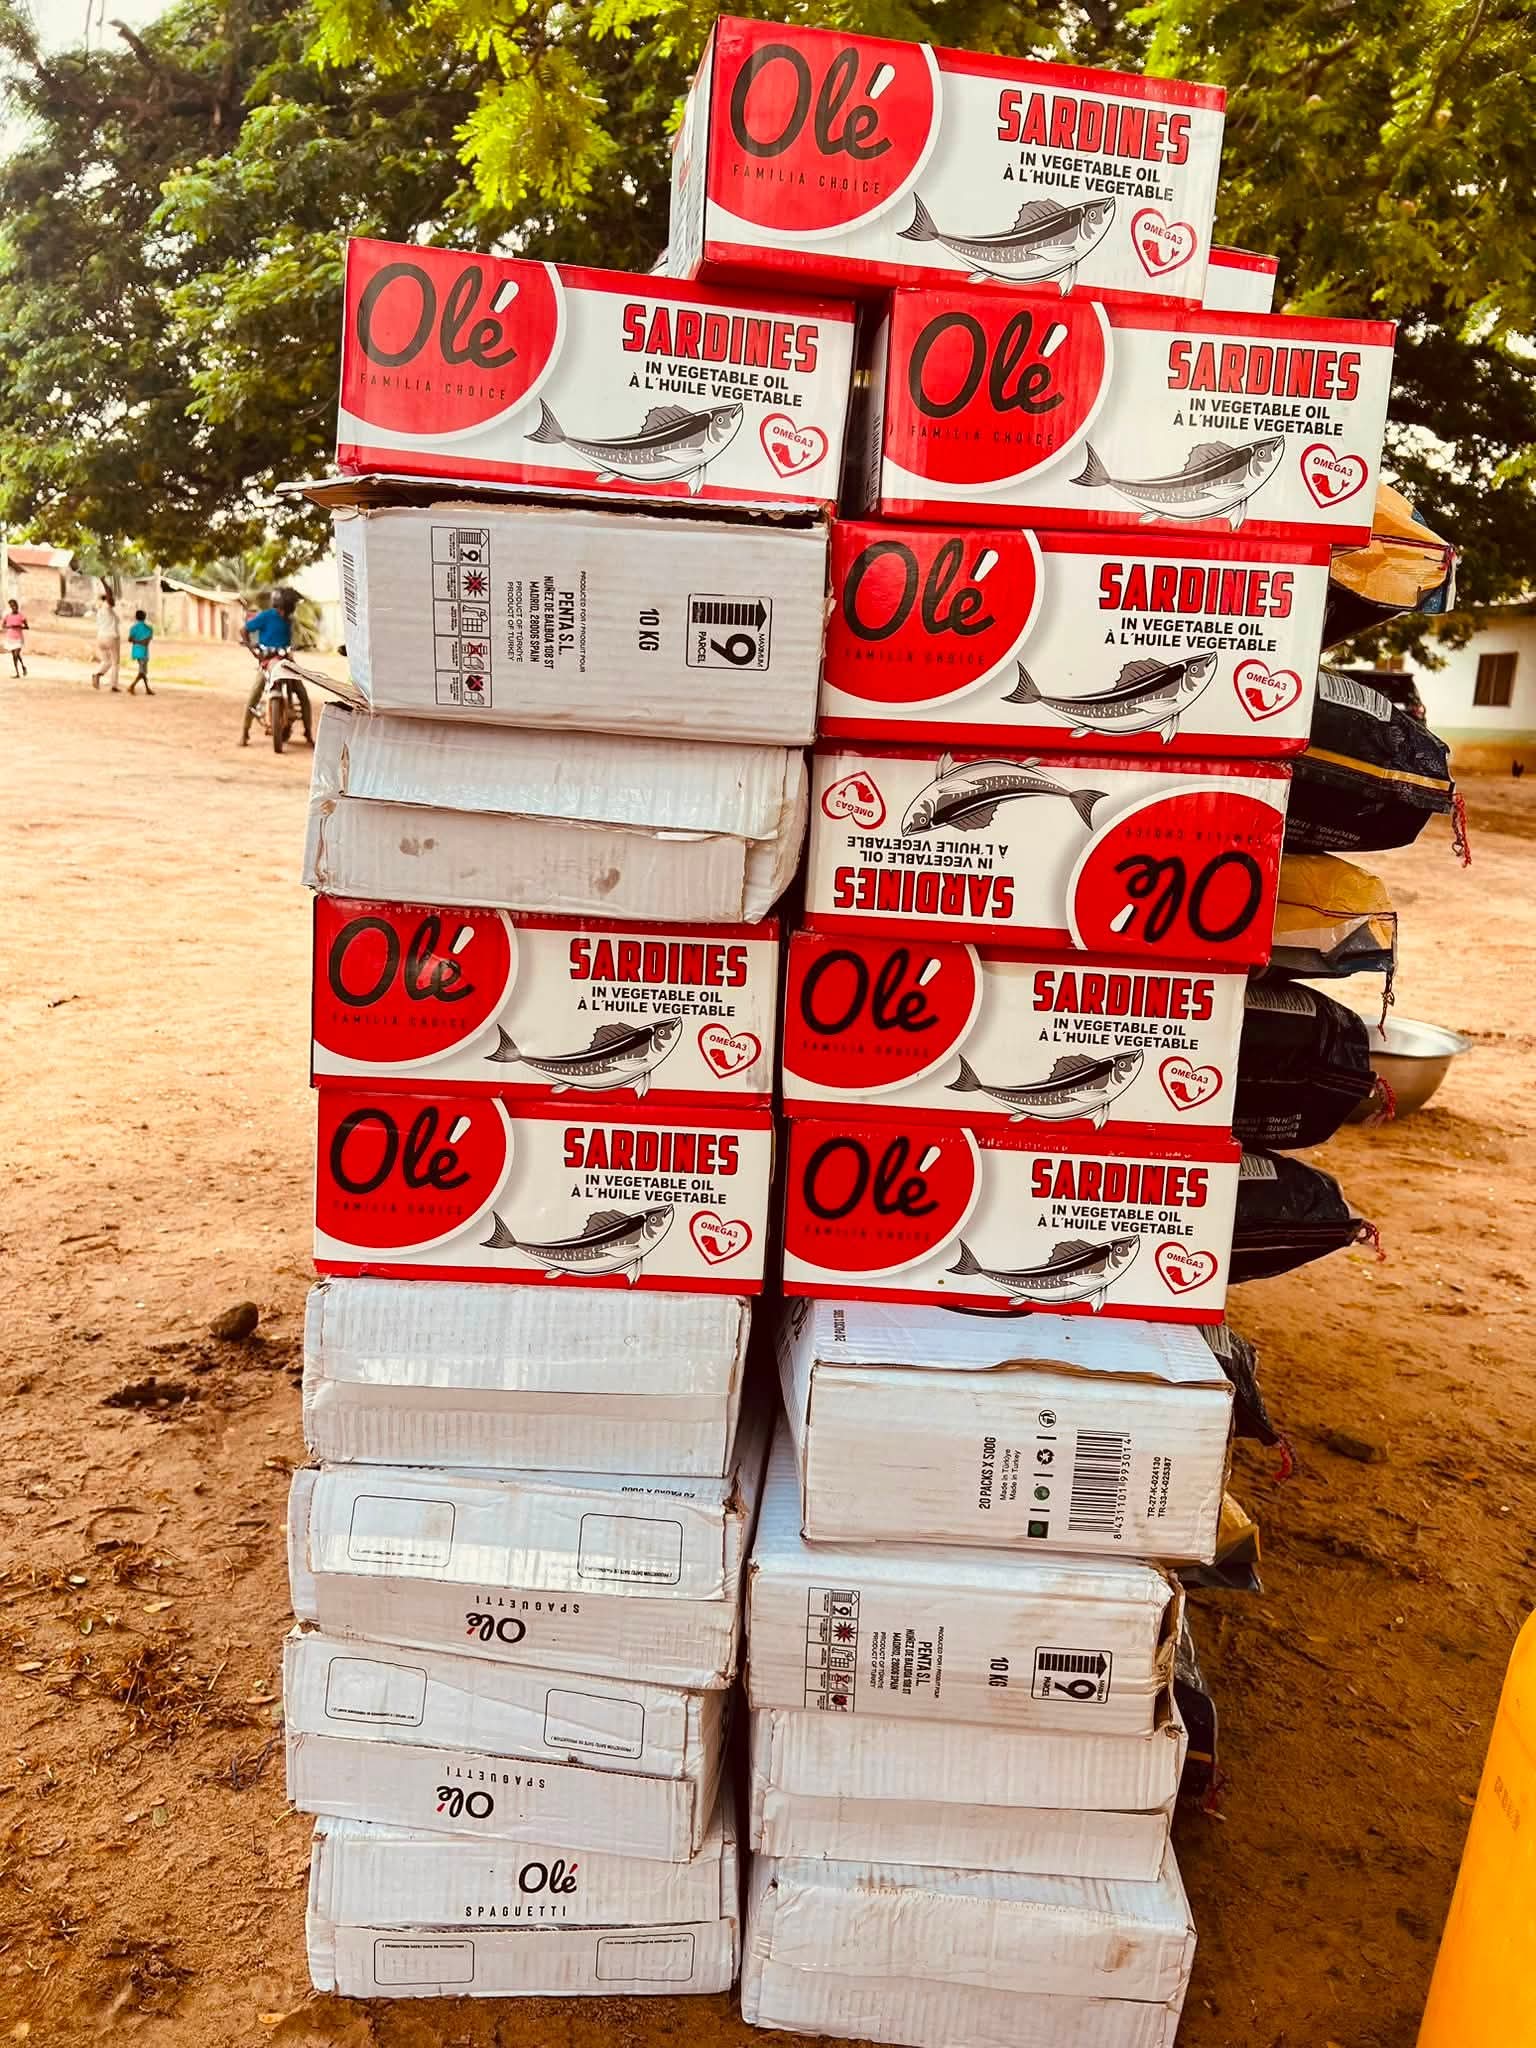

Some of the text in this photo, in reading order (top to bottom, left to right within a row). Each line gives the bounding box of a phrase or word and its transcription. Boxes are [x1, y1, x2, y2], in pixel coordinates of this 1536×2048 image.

[730, 43, 896, 159] Olé
[997, 89, 1191, 164] SARDINES
[1020, 152, 1161, 182] IN VEGETABLE OIL
[1003, 164, 1013, 180] À
[1085, 178, 1174, 201] VEGETABLE
[1144, 222, 1183, 244] OMEGA3
[357, 262, 519, 368] Olé
[622, 303, 819, 373] SARDINES
[646, 361, 789, 389] IN VEGETABLE OIL
[909, 311, 1067, 418] Olé
[1167, 340, 1361, 400] SARDINES
[361, 373, 505, 400] FAMILIA CHOICE
[629, 372, 639, 387] À
[711, 386, 802, 407] VEGETABLE
[1190, 398, 1330, 419] IN VEGETABLE OIL
[773, 426, 814, 447] OMEGA3
[1173, 410, 1183, 425] À
[1254, 419, 1343, 436] VEGETABLE
[1313, 457, 1353, 476] OMEGA3
[842, 538, 999, 641] Olé
[1099, 563, 1294, 617] SARDINES
[544, 602, 553, 612] DE
[508, 619, 514, 630] OF
[516, 619, 522, 630] OF
[529, 581, 540, 662] MADRID, 28006 SPAIN
[544, 614, 554, 643] BALBOA
[559, 592, 574, 655] PENTA S.L.
[639, 608, 659, 651] 10 KG
[1121, 618, 1263, 636] IN VEGETABLE OIL
[544, 645, 553, 658] 108
[697, 631, 707, 663] PARCEL
[711, 633, 756, 665] 9
[757, 633, 765, 667] MAXIMUM
[1105, 629, 1115, 644] À
[1186, 637, 1277, 651] VEGETABLE
[544, 660, 553, 669] ST
[1246, 672, 1287, 690] OMEGA3
[835, 800, 874, 818] OMEGA3
[847, 836, 931, 850] VEGETABLE
[999, 845, 1008, 859] À
[860, 851, 992, 869] IN VEGETABLE OIL
[834, 867, 1014, 918] SARDINES
[1110, 851, 1265, 944] Olé
[328, 915, 475, 1007] Olé
[570, 938, 747, 987] SARDINES
[592, 987, 722, 1003] IN VEGETABLE OIL
[799, 948, 941, 1035] Olé
[1033, 971, 1214, 1020] SARDINES
[578, 997, 587, 1009] À
[652, 1004, 735, 1016] VEGETABLE
[1039, 1028, 1048, 1041] À
[1114, 1036, 1199, 1050] VEGETABLE
[1054, 1018, 1186, 1035] IN VEGETABLE OIL
[709, 1034, 747, 1051] OMEGA3
[1171, 1067, 1209, 1084] OMEGA3
[331, 1105, 472, 1194] Olé
[564, 1128, 739, 1175] SARDINES
[586, 1175, 714, 1190] IN VEGETABLE OIL
[801, 1135, 940, 1220] Olé
[1031, 1158, 1208, 1207] SARDINES
[571, 1184, 580, 1197] À
[644, 1191, 726, 1204] VEGETABLE
[1038, 1214, 1047, 1226] À
[1111, 1222, 1194, 1236] VEGETABLE
[1052, 1205, 1181, 1222] IN VEGETABLE OIL
[701, 1222, 738, 1238] OMEGA3
[1167, 1253, 1204, 1269] OMEGA3
[983, 1436, 996, 1459] 500G
[1001, 1449, 1011, 1473] Türkiye
[1120, 1438, 1131, 1481] 993014
[1012, 1450, 1021, 1473] Turkey
[980, 1469, 993, 1496] PACKS
[1000, 1482, 1008, 1500] Made
[1010, 1482, 1018, 1500] Made
[1147, 1457, 1161, 1517] TR-27-K-024130
[1158, 1457, 1172, 1517] TR-33-K-025387
[979, 1498, 991, 1509] 20
[1114, 1488, 1127, 1528] 431101
[475, 1594, 580, 1614] SPAGUETTI
[465, 1612, 527, 1643] Olé
[917, 1641, 932, 1670] PENTA
[988, 1657, 1009, 1687] 10 KG
[1054, 1679, 1096, 1699] 9
[446, 1765, 545, 1789] SPAGUETTI
[437, 1785, 495, 1818] Olé
[518, 1859, 579, 1893] Olé
[465, 1905, 568, 1918] SPAGUETTI
